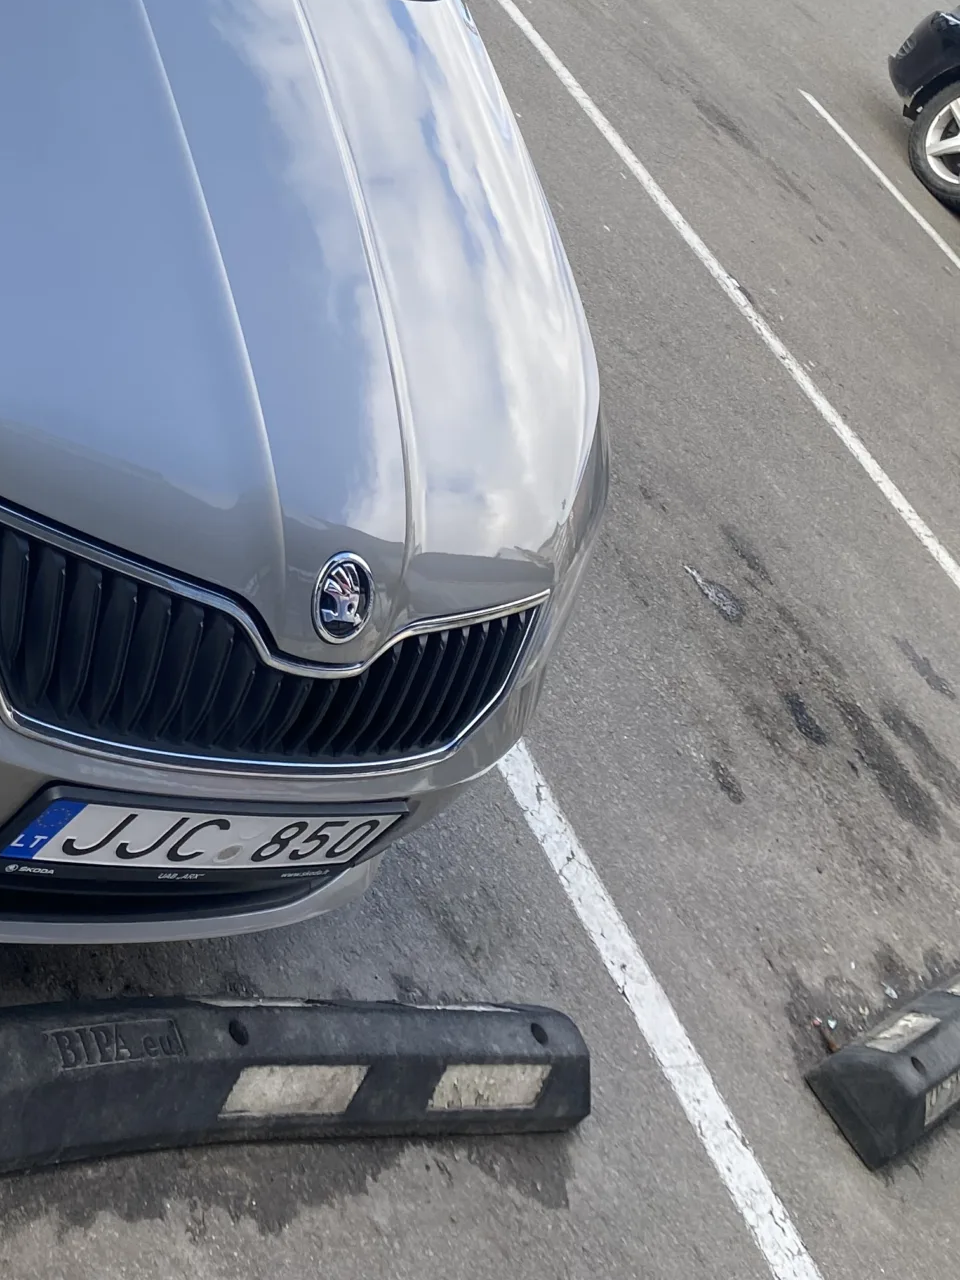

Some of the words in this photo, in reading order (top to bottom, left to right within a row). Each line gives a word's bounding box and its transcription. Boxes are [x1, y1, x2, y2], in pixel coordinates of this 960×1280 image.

[10, 834, 48, 848] LT
[62, 814, 231, 862] JJC
[251, 820, 380, 862] 850
[157, 872, 177, 880] UAB
